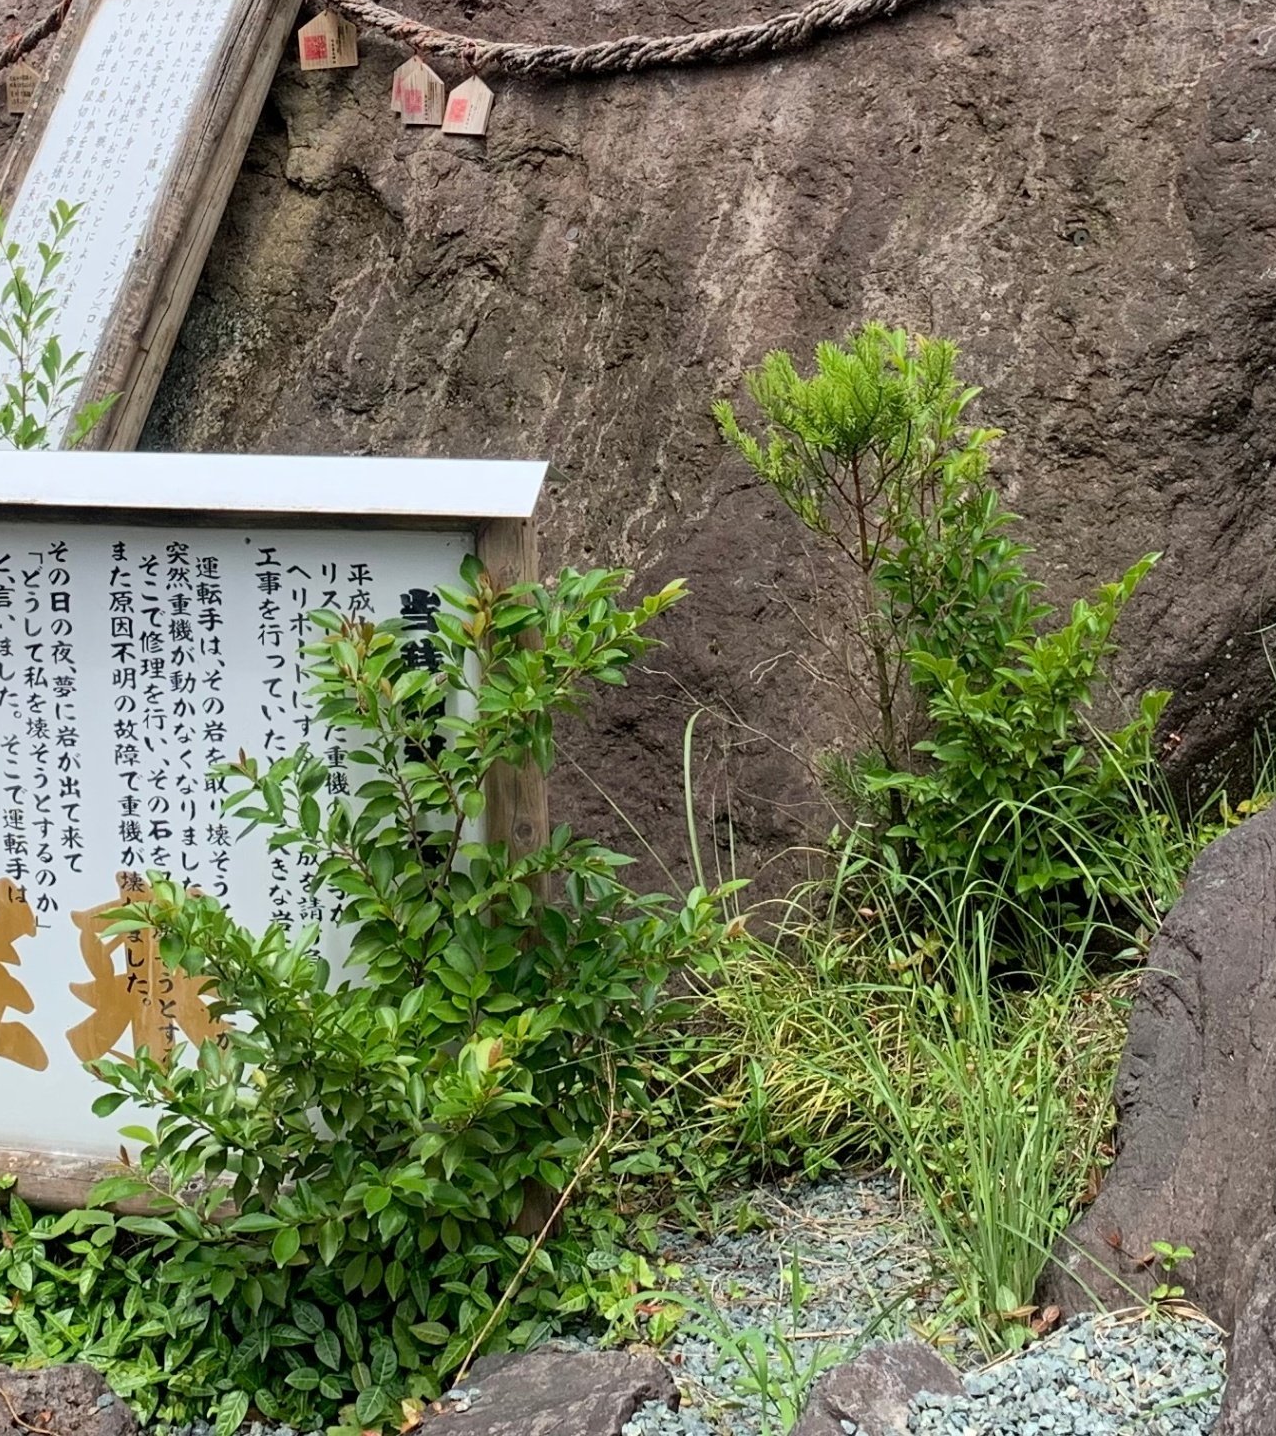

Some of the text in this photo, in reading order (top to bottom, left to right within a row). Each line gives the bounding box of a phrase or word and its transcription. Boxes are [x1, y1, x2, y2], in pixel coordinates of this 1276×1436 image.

[47, 540, 84, 873] その日の夜、夢に岩が出て来て
[109, 541, 151, 1006] また原因不明の故障で重機が壊ました。
